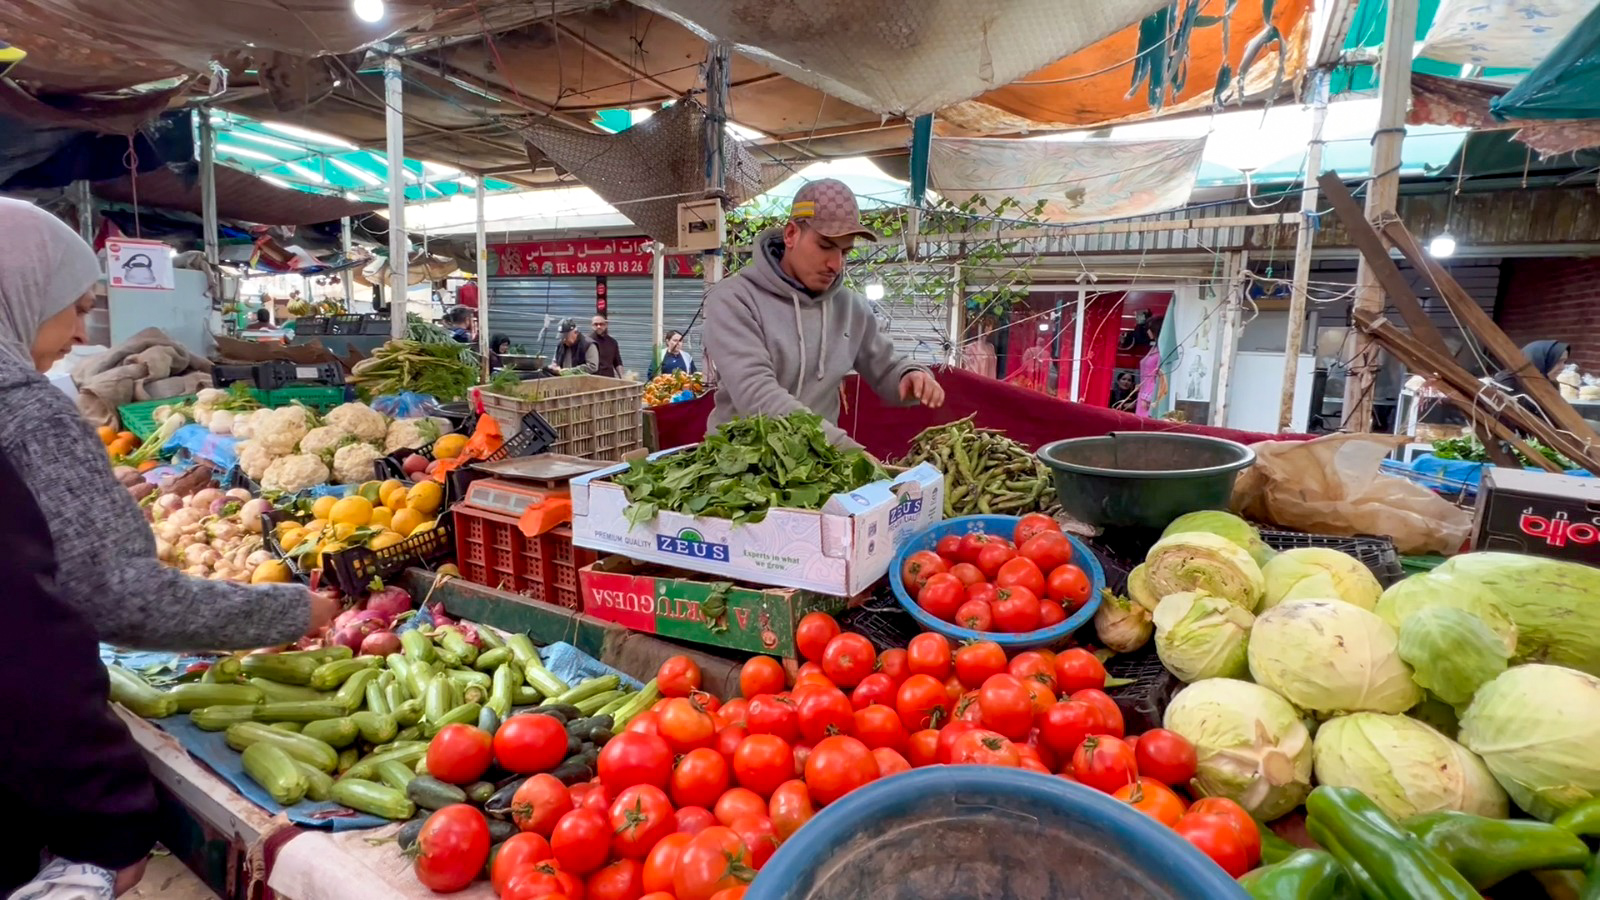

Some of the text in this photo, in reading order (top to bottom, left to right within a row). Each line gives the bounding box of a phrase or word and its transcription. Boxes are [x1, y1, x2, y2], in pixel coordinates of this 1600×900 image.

[525, 244, 575, 260] فاس
[577, 240, 616, 257] أهل
[576, 262, 588, 273] 06
[590, 262, 601, 273] 59
[603, 261, 615, 272] 78
[617, 261, 629, 272] 18
[631, 260, 643, 272] 26
[890, 500, 921, 523] ZEUS
[594, 530, 651, 548] PREMIUM QUALITY
[1519, 513, 1600, 547] olla
[660, 536, 724, 559] ZEUS
[743, 549, 770, 560] Experts
[781, 556, 800, 564] what
[591, 587, 751, 631] A RTUGUESA
